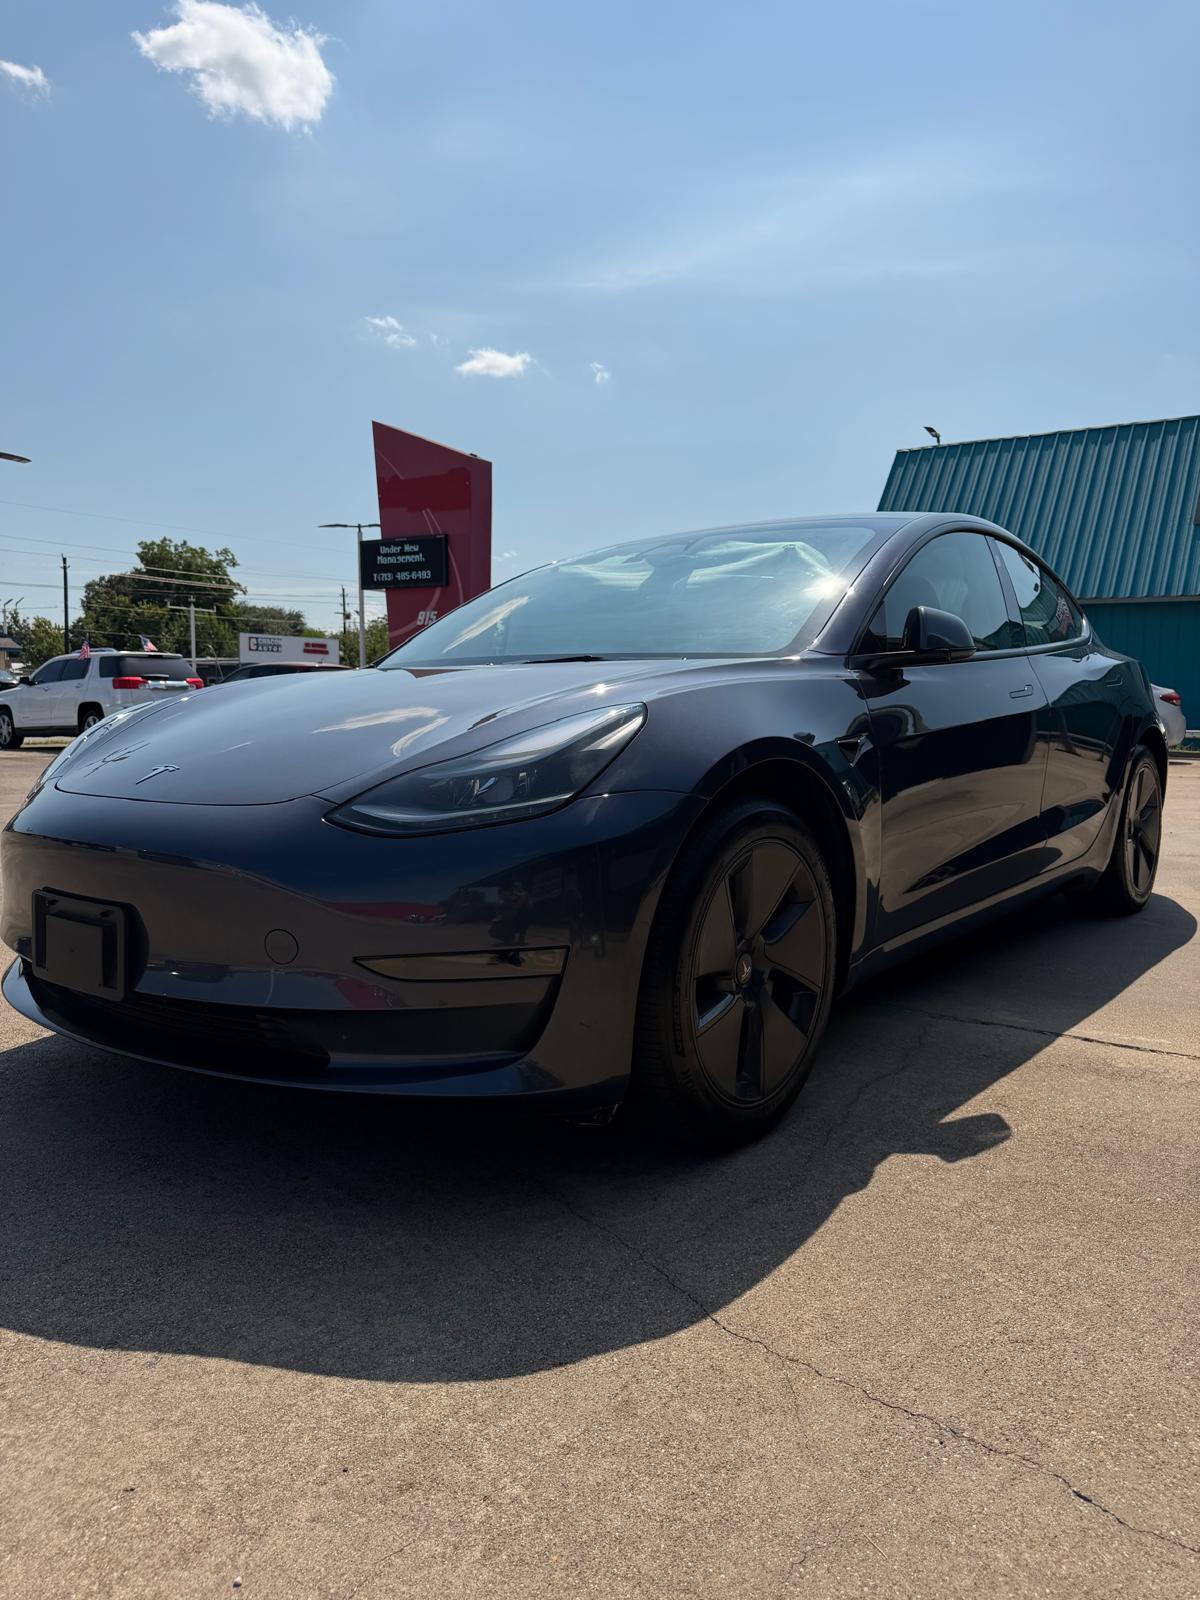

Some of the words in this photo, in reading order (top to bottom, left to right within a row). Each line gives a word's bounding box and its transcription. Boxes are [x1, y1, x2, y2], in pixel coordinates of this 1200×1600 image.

[380, 544, 402, 554] Under
[404, 543, 419, 553] New
[416, 610, 438, 625] 915
